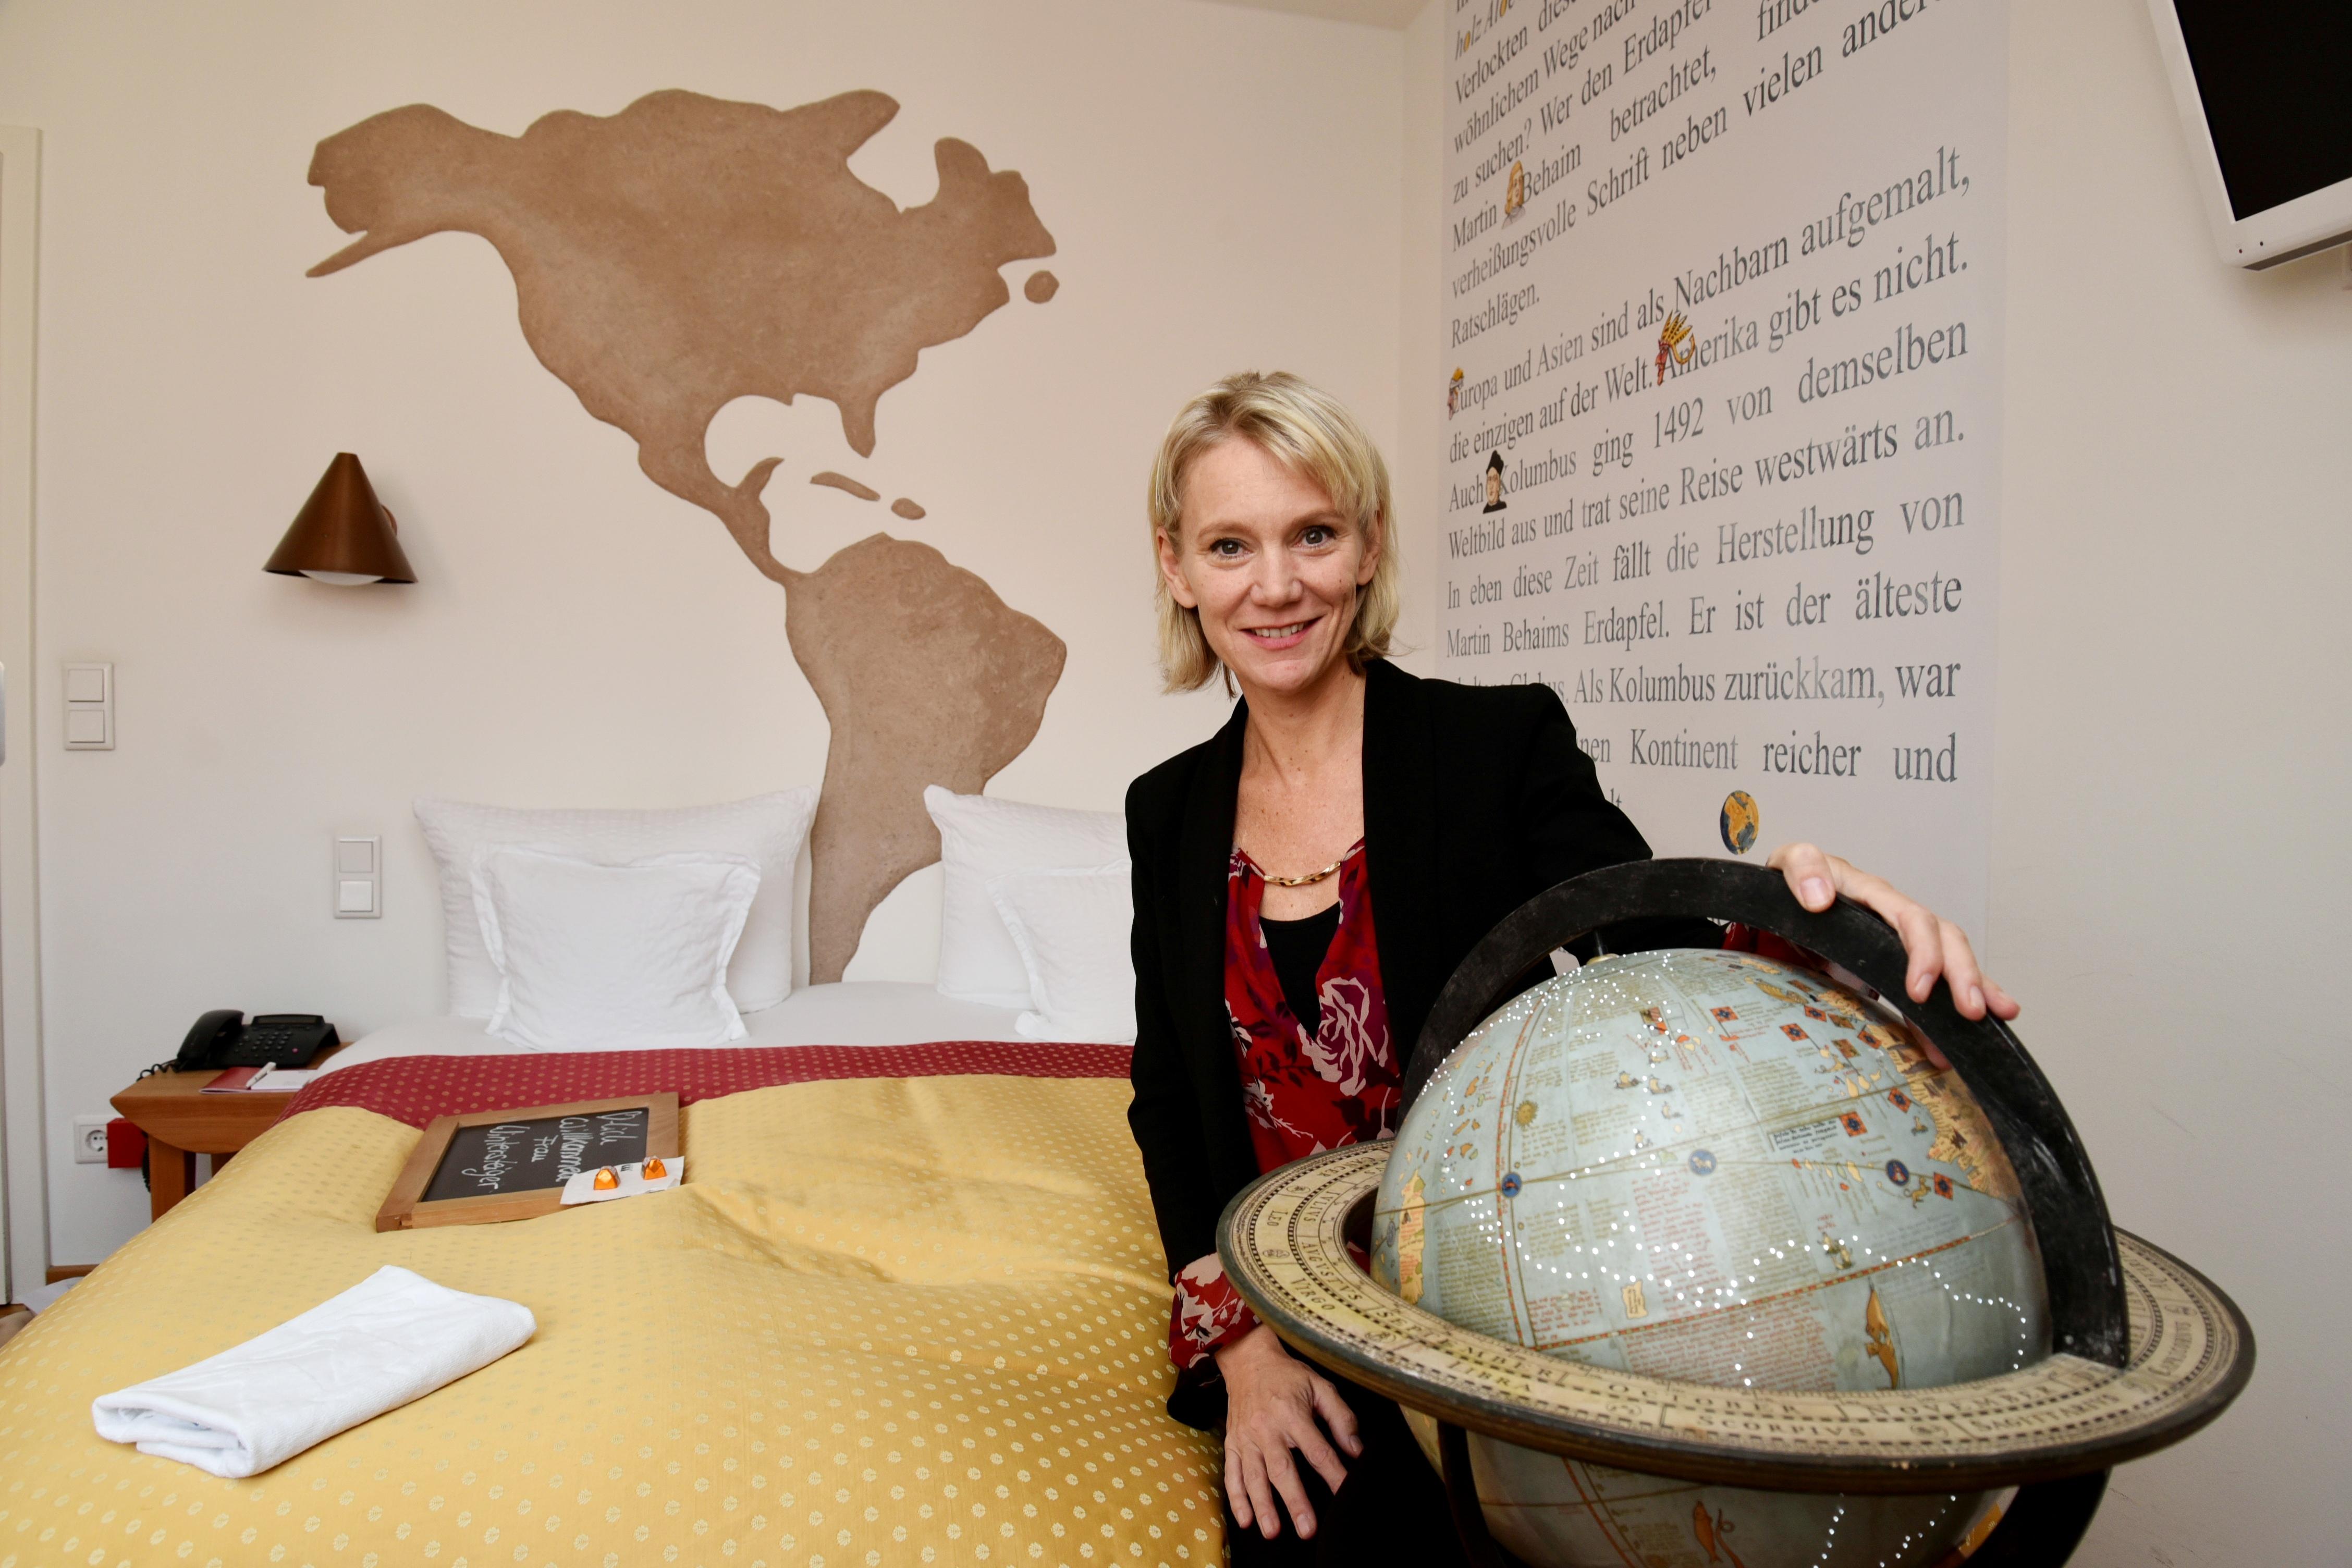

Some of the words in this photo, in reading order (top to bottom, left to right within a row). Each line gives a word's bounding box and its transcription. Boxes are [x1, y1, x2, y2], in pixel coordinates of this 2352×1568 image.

[1454, 68, 1539, 154] wöhnlichem
[1544, 26, 1588, 79] Wege
[1455, 26, 1528, 104] Verlockten
[1452, 199, 1576, 299] verheißungsvolle
[1588, 146, 1649, 217] Schrift
[1662, 106, 1728, 171] neben
[1743, 46, 1824, 117] vielen
[1453, 175, 1468, 204] zu
[1475, 118, 1532, 188] suchen?
[1540, 93, 1573, 136] Wer
[1582, 63, 1613, 106] den
[1453, 201, 1497, 252] Martin
[1610, 44, 1717, 142] betrachtet,
[1452, 375, 1498, 413] uropa
[1504, 349, 1532, 391] und
[1537, 333, 1584, 377] Asien
[1591, 301, 1628, 352] sind
[1637, 288, 1665, 330] als
[1674, 236, 1789, 312] Nachbarn
[1801, 145, 1970, 255] aufgemalt,
[1452, 284, 1540, 348] Ratschlägen.
[1450, 432, 1469, 463] die
[1474, 411, 1534, 450] einzigen
[1539, 387, 1567, 430] auf
[1571, 382, 1599, 417] der
[1604, 355, 1652, 403] Welt.
[1769, 287, 1822, 353] gibt
[1832, 278, 1861, 317] es
[1873, 231, 1967, 303] nicht.
[1449, 474, 1484, 512] Auch
[1592, 428, 1634, 476] ging
[1655, 397, 1704, 449] 1492
[1726, 384, 1773, 424] von
[1798, 321, 1968, 403] demselben
[1449, 517, 1505, 559] Weltbild
[1512, 518, 1536, 545] aus
[1544, 497, 1574, 538] und
[1582, 493, 1611, 529] trat
[1620, 478, 1670, 520] seine
[1680, 458, 1743, 506] Reise
[1755, 419, 1897, 487] westwärts
[1915, 409, 1964, 451] an.
[1447, 580, 1460, 609] In
[1470, 575, 1502, 606] eben
[1513, 565, 1552, 598] diese
[1564, 551, 1599, 590] Zeit
[1613, 540, 1651, 582] fällt
[1667, 532, 1699, 573] die
[1717, 505, 1875, 564] Herstellung
[1900, 490, 1965, 535] von
[1447, 624, 1491, 658] Martin
[1503, 615, 1569, 653] Behaims
[1583, 599, 1669, 651] Erdapfel.
[1689, 596, 1716, 635] Er
[1735, 589, 1765, 631] ist
[1786, 581, 1831, 627] der
[1855, 570, 1962, 620] älteste
[1573, 668, 1603, 704] Als
[1609, 663, 1716, 703] Kolumbus
[1724, 654, 1885, 709] zurückkam,
[1895, 662, 1961, 699] war
[1630, 728, 1738, 770] Kontinent
[1762, 730, 1862, 777] reicher
[1893, 732, 1958, 782] und
[531, 1135, 559, 1163] Frau
[1267, 1210, 1289, 1227] LEO
